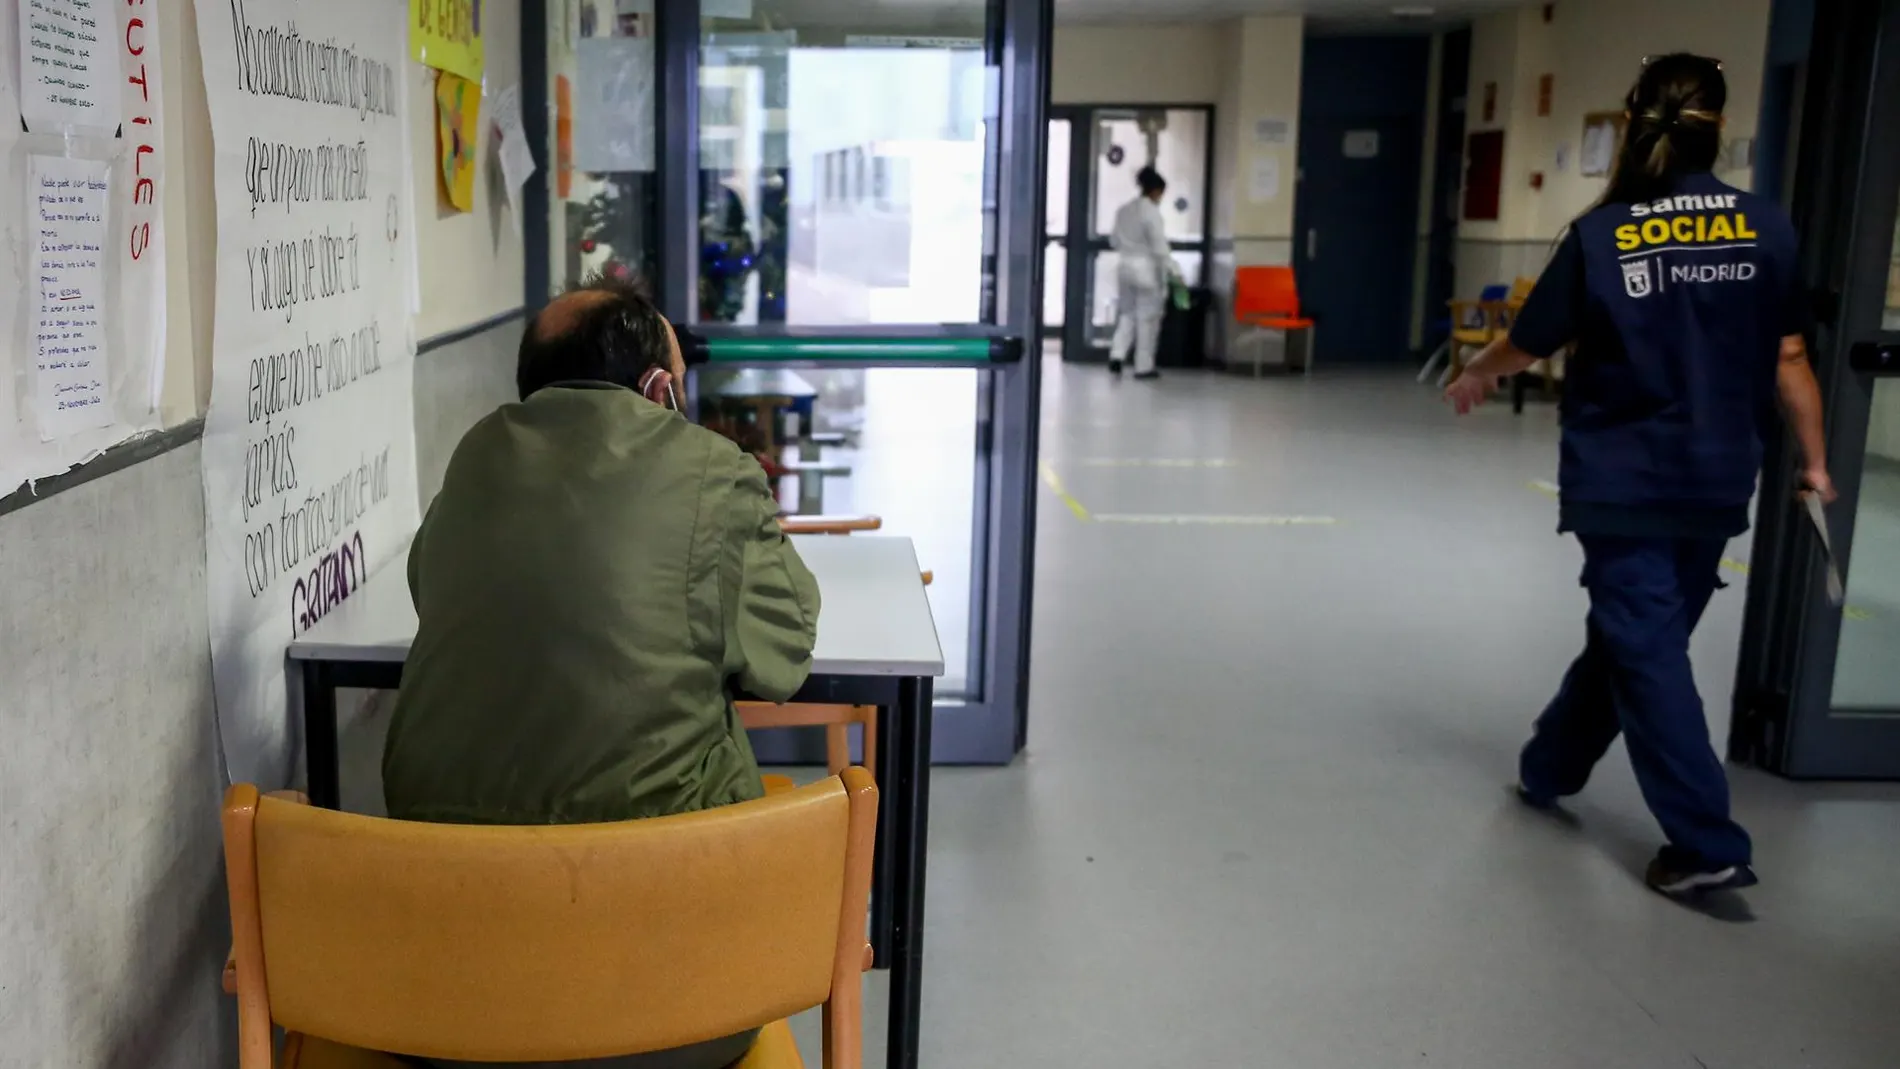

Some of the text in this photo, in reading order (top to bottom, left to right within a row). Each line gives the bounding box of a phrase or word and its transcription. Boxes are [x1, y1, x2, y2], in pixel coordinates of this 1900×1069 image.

[1614, 212, 1759, 251] SOCIAL
[1630, 193, 1738, 218] samur
[273, 239, 299, 324] algo
[319, 223, 346, 298] sobre
[1670, 262, 1757, 284] MADRID
[305, 330, 323, 402] he
[244, 522, 277, 598] con
